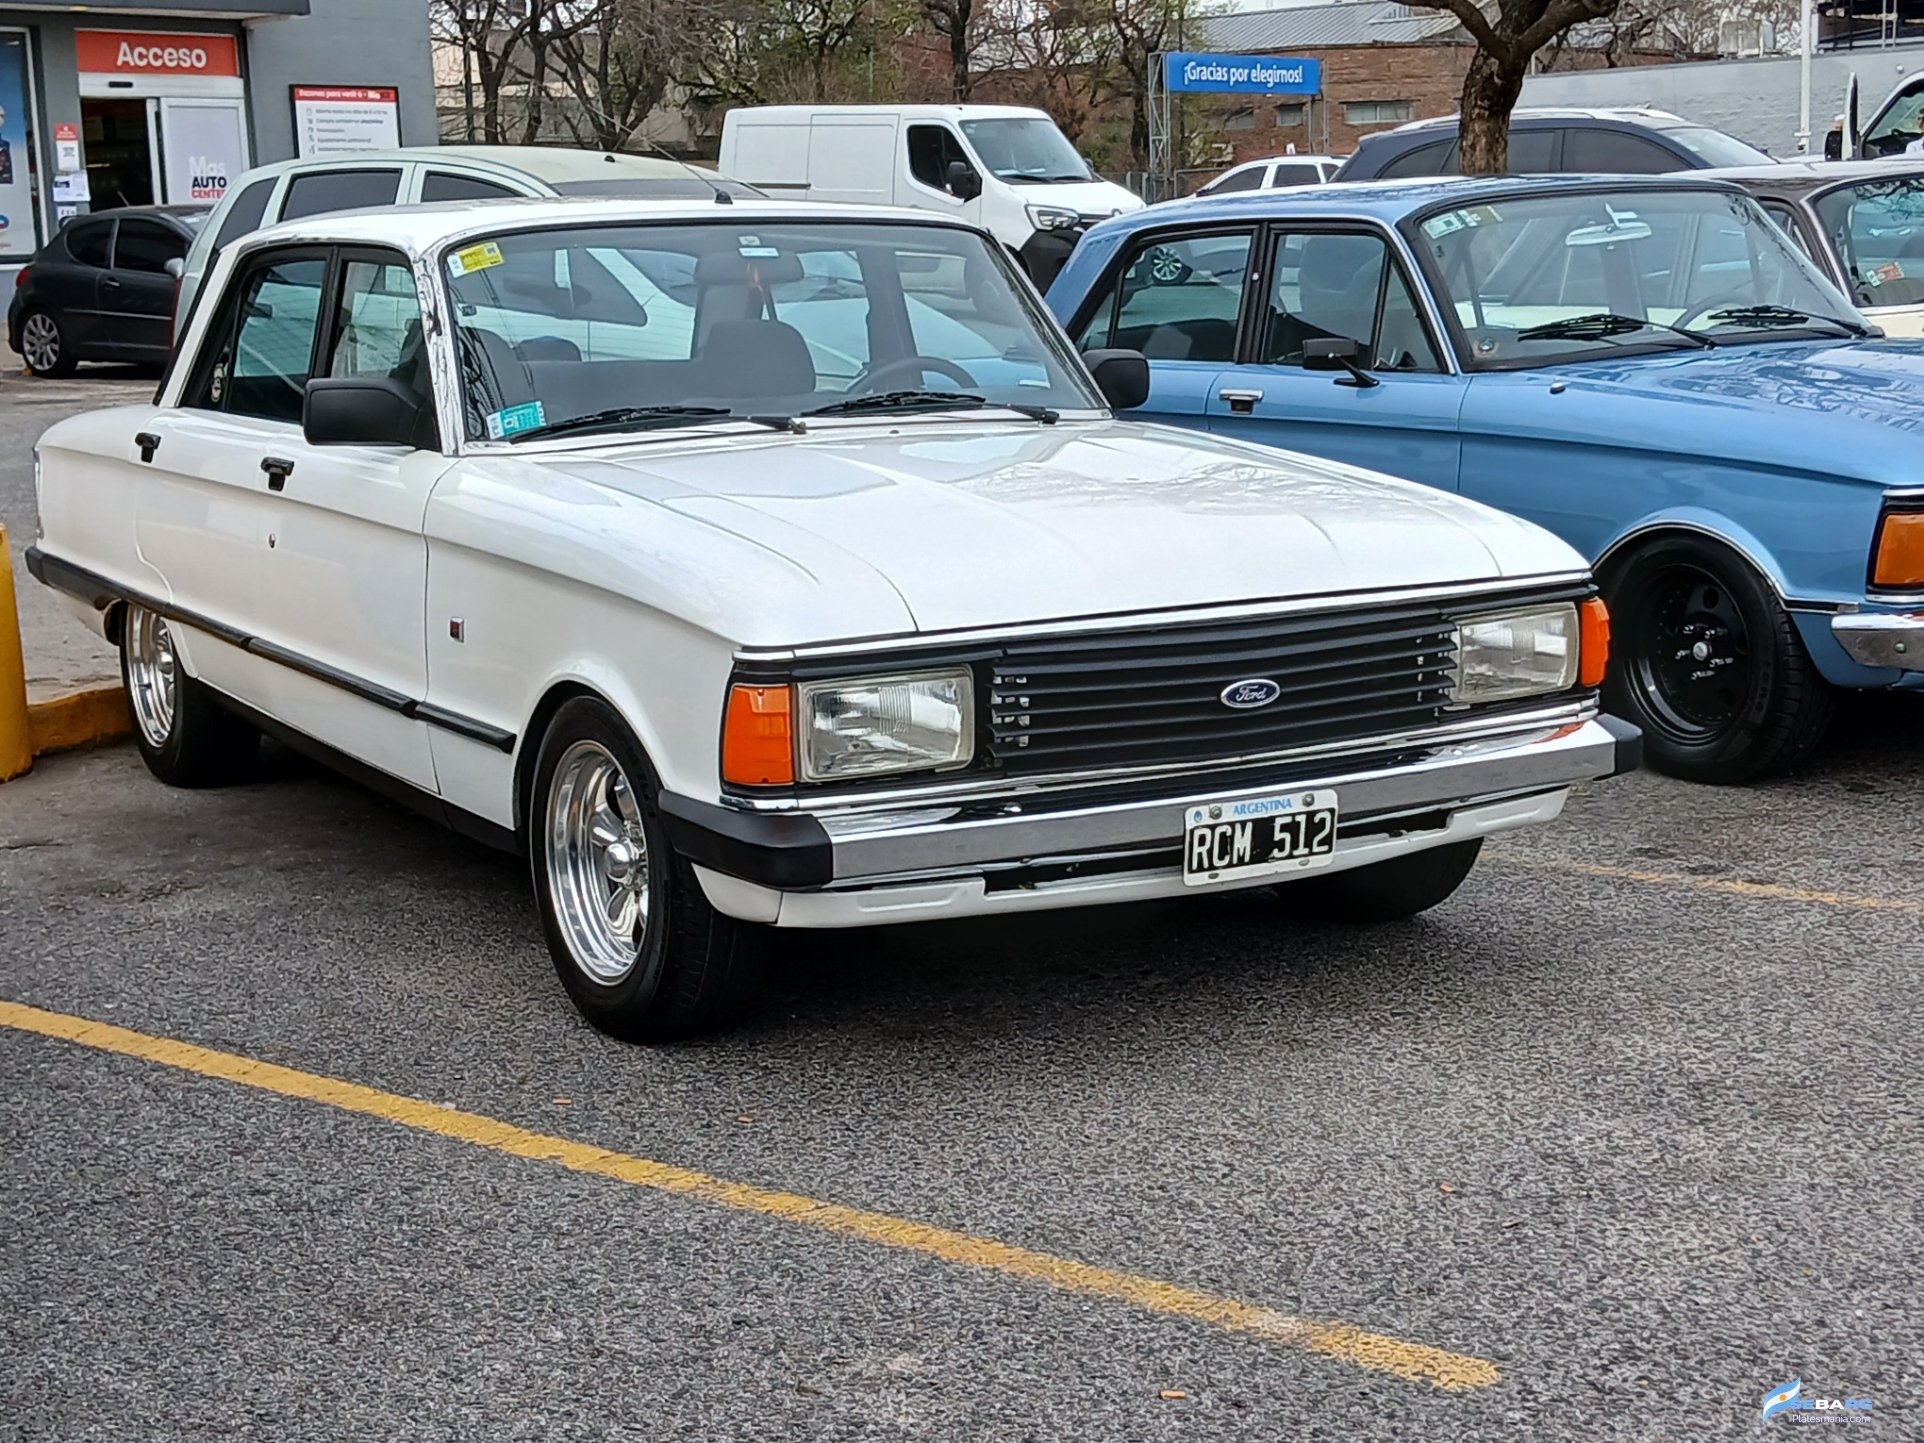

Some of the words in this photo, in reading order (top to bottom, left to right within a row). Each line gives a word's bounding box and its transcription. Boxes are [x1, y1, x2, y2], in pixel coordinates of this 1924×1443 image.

[116, 41, 207, 69] Acceso
[1184, 61, 1228, 85] ¡Gracias
[1230, 66, 1249, 87] por
[1251, 63, 1303, 88] elegirnos!
[192, 176, 227, 189] AUTO
[191, 189, 225, 199] CENTE
[1235, 684, 1267, 701] Ford
[1232, 798, 1293, 816] ARGENTINA
[1191, 821, 1253, 870] RCM
[1271, 810, 1332, 858] 512
